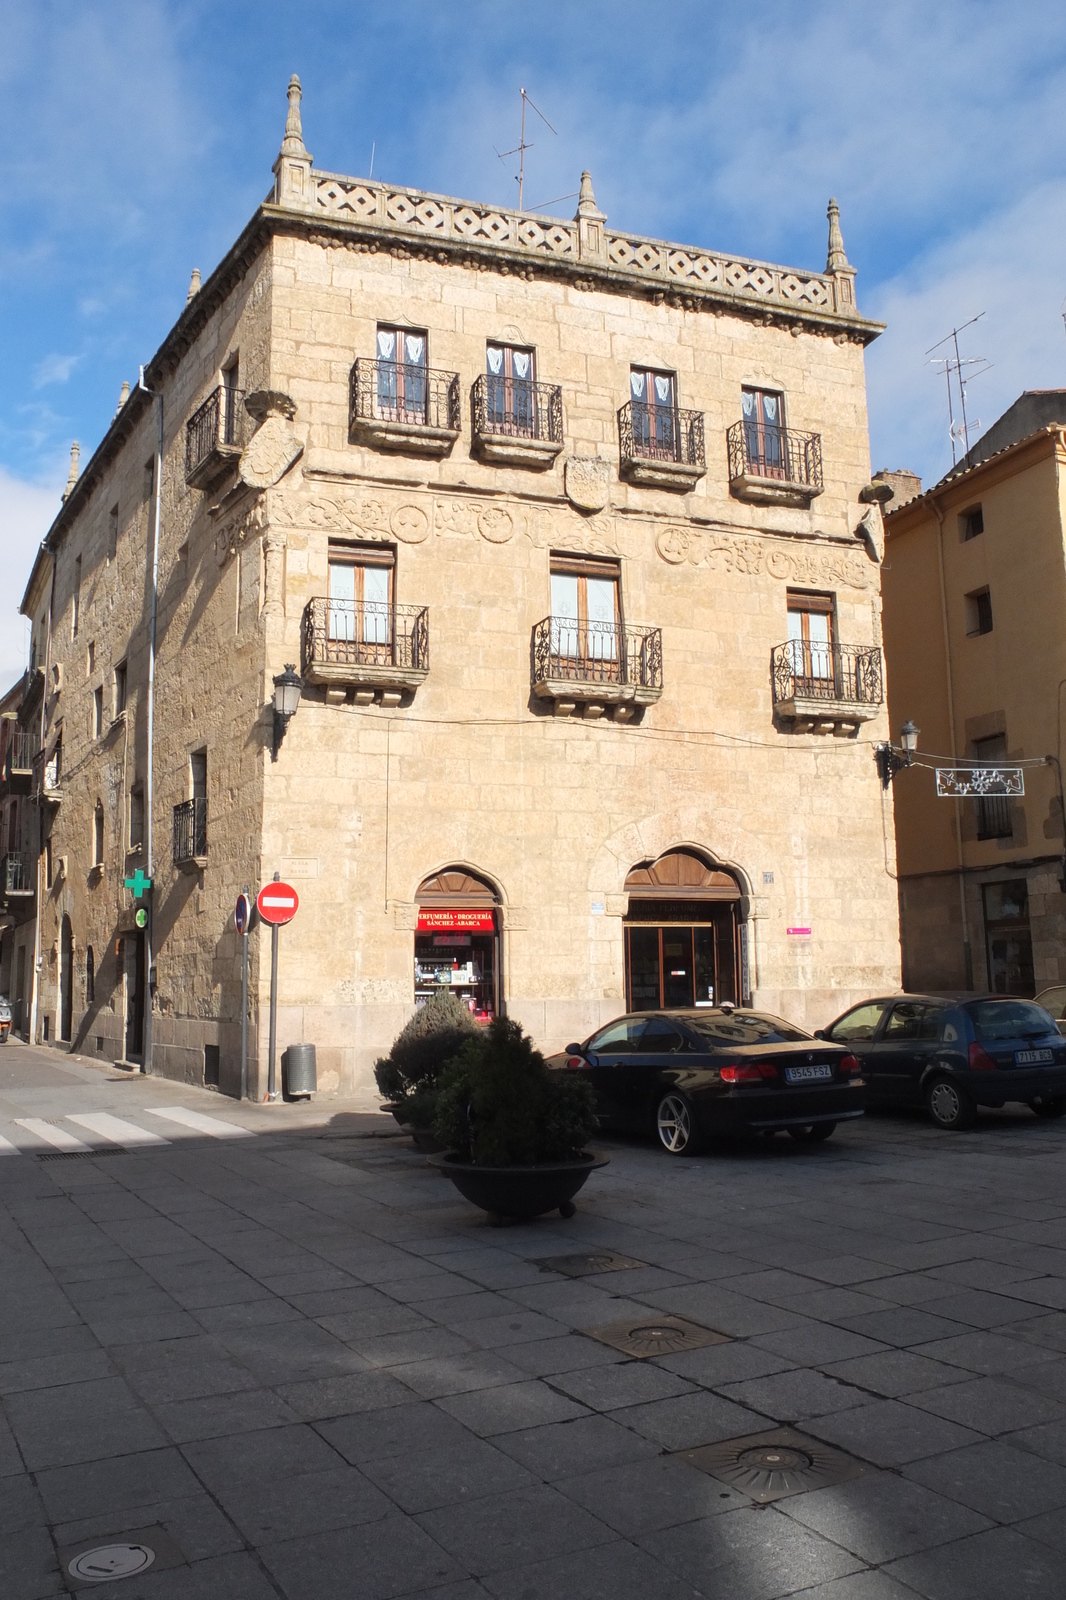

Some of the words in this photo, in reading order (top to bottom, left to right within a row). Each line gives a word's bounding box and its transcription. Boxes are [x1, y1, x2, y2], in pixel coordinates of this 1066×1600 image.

[417, 912, 453, 920] ERFUMERÍA
[457, 912, 492, 920] DROGUERÍA
[1019, 1051, 1036, 1062] 7115
[791, 1067, 812, 1079] 9545
[813, 1065, 830, 1076] FSZ
